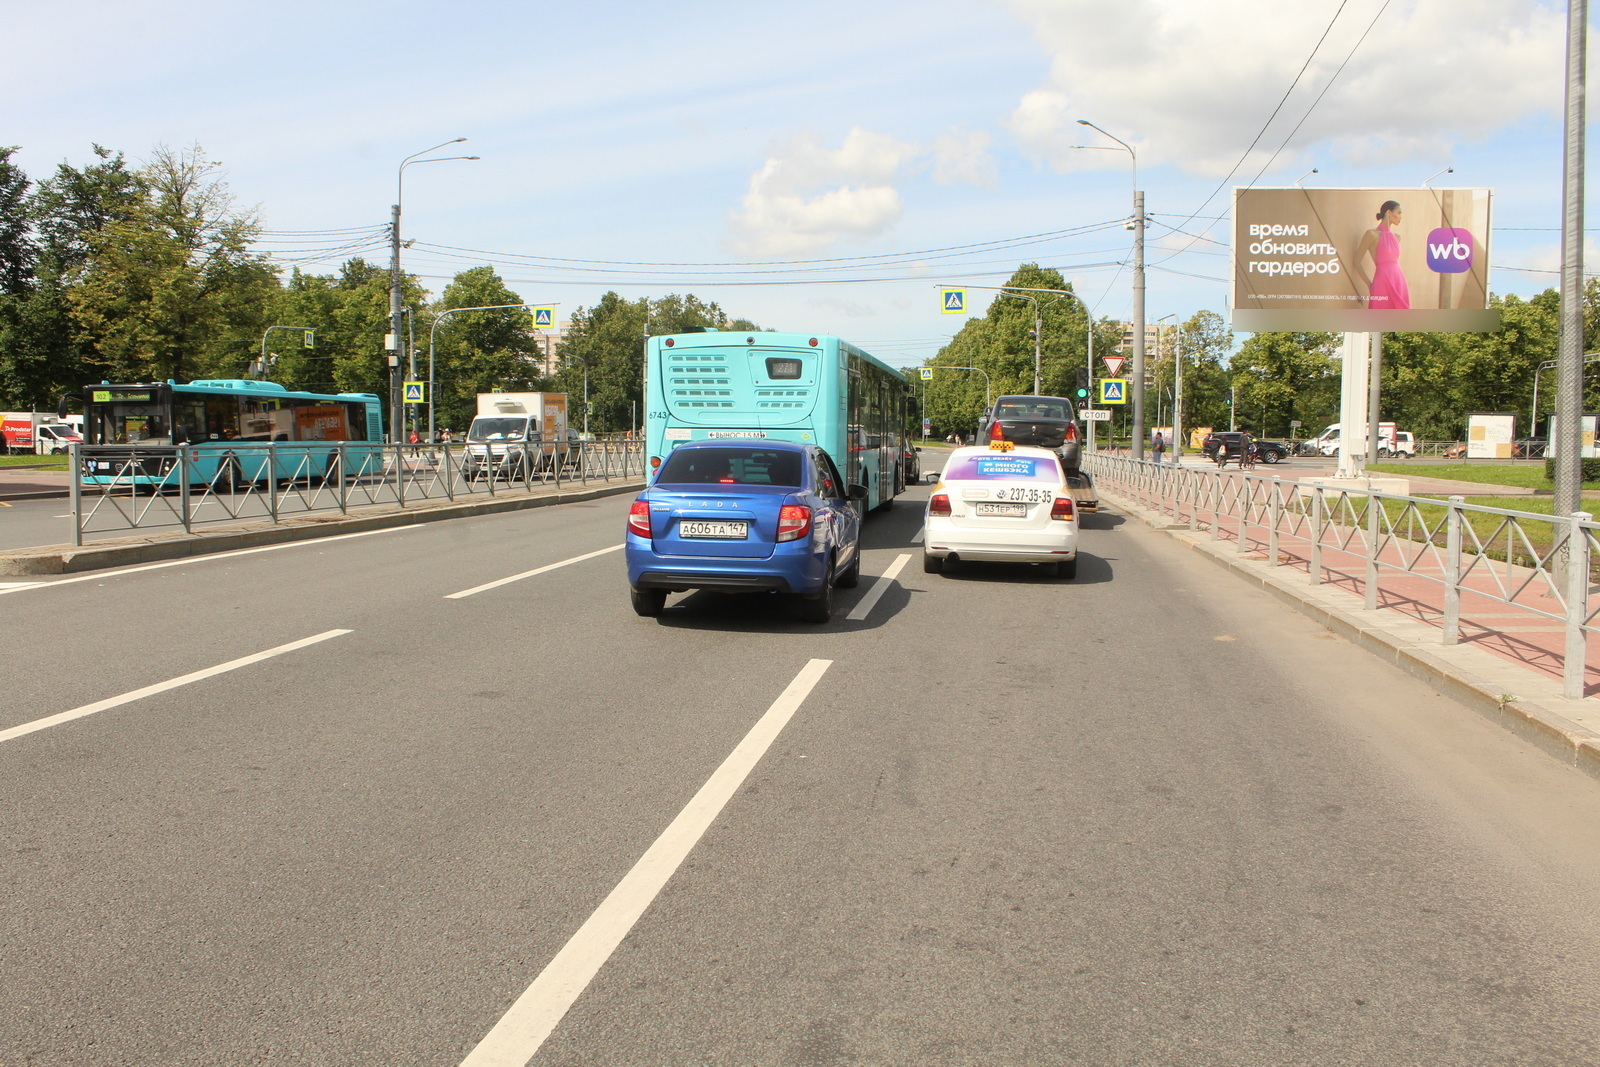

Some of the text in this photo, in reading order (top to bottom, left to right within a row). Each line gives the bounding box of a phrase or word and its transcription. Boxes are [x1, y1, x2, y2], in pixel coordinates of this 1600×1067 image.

[1249, 224, 1309, 240] время
[1249, 238, 1337, 255] обновить
[1429, 236, 1471, 260] wb
[1249, 257, 1340, 277] гардероб
[648, 411, 667, 420] 6743
[1084, 411, 1106, 419] СТОП
[1010, 487, 1052, 503] 237-35-35
[978, 504, 1010, 513] Н531ЕР
[682, 522, 744, 534] А606ТА 147
